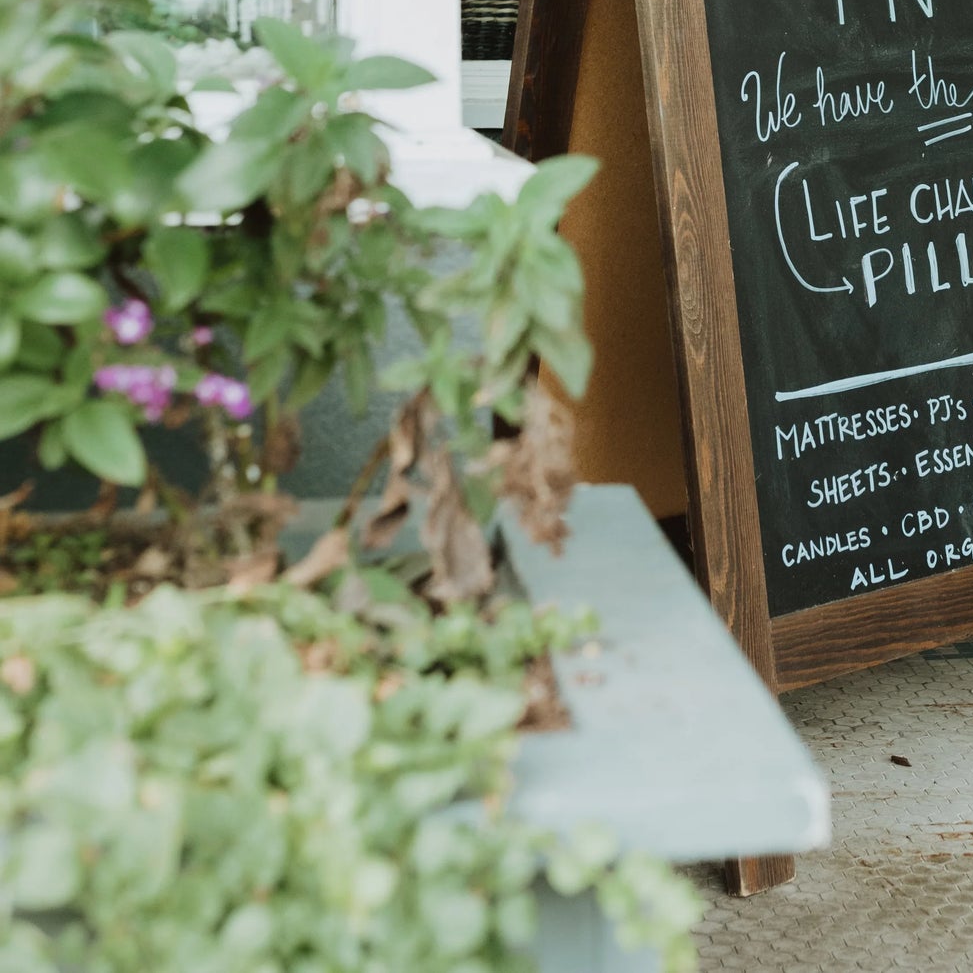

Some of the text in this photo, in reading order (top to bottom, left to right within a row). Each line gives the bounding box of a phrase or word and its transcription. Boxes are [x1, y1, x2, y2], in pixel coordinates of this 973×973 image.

[740, 51, 801, 142] We
[813, 66, 894, 126] have
[802, 178, 890, 242] LIFE
[775, 403, 912, 460] MATTRESSES
[806, 462, 891, 508] SHEETS
[781, 527, 872, 568] CANDLES
[901, 507, 950, 538] CBD
